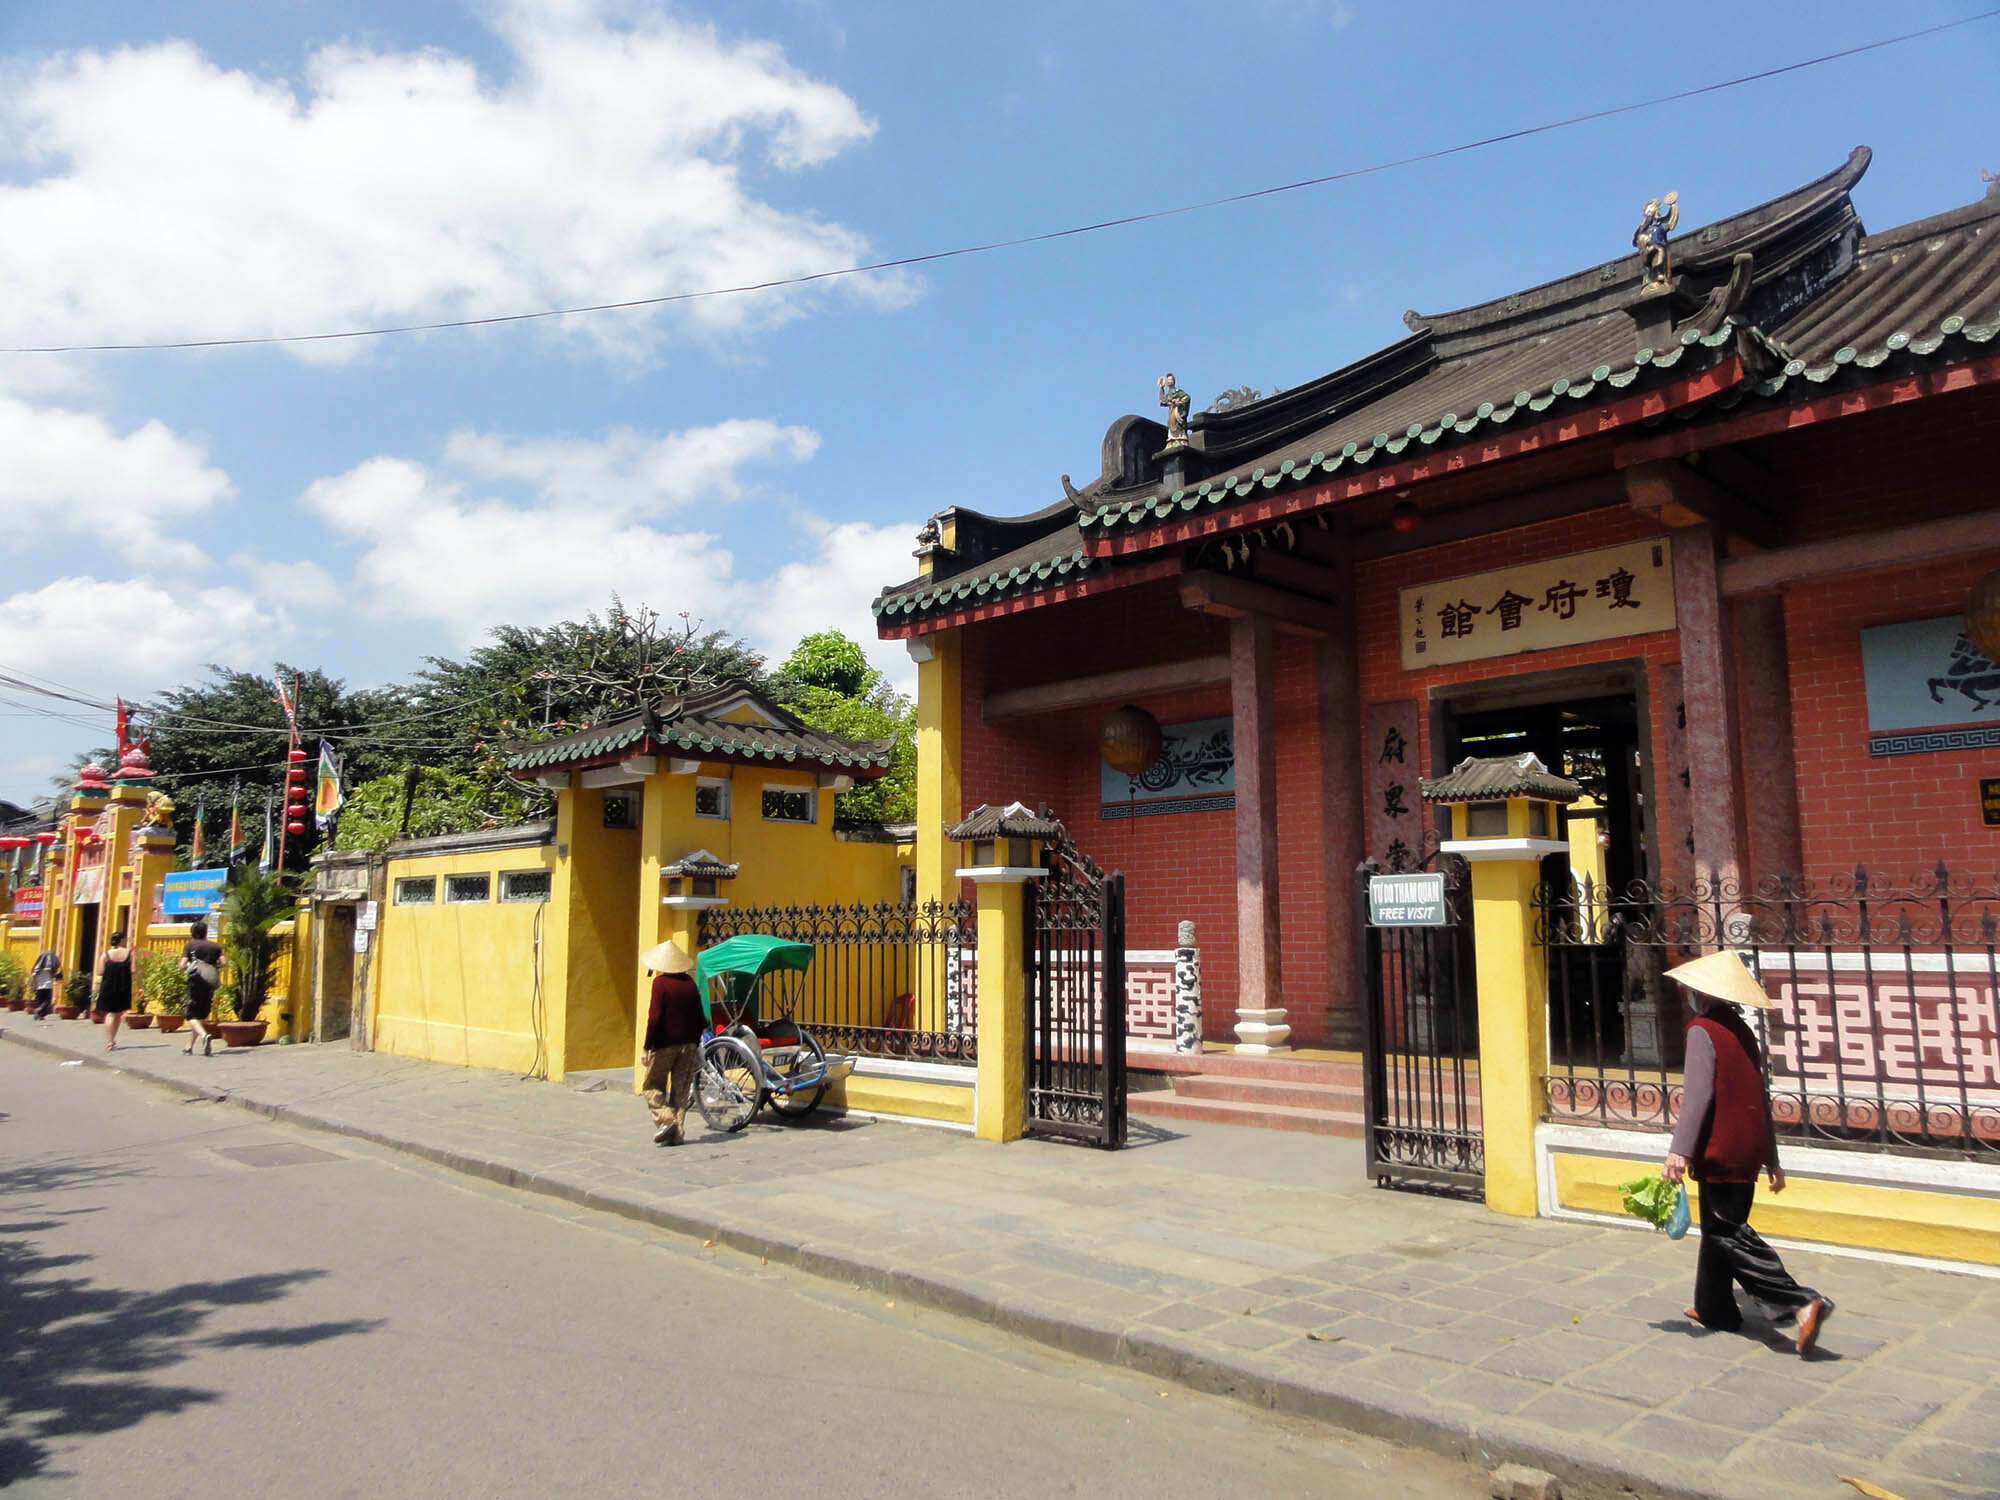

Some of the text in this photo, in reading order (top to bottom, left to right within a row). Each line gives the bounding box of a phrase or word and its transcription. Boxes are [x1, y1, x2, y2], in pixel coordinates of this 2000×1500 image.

[1394, 882, 1417, 904] THAM
[1418, 881, 1440, 904] QUAN
[1379, 906, 1436, 921] FREE VISIT
